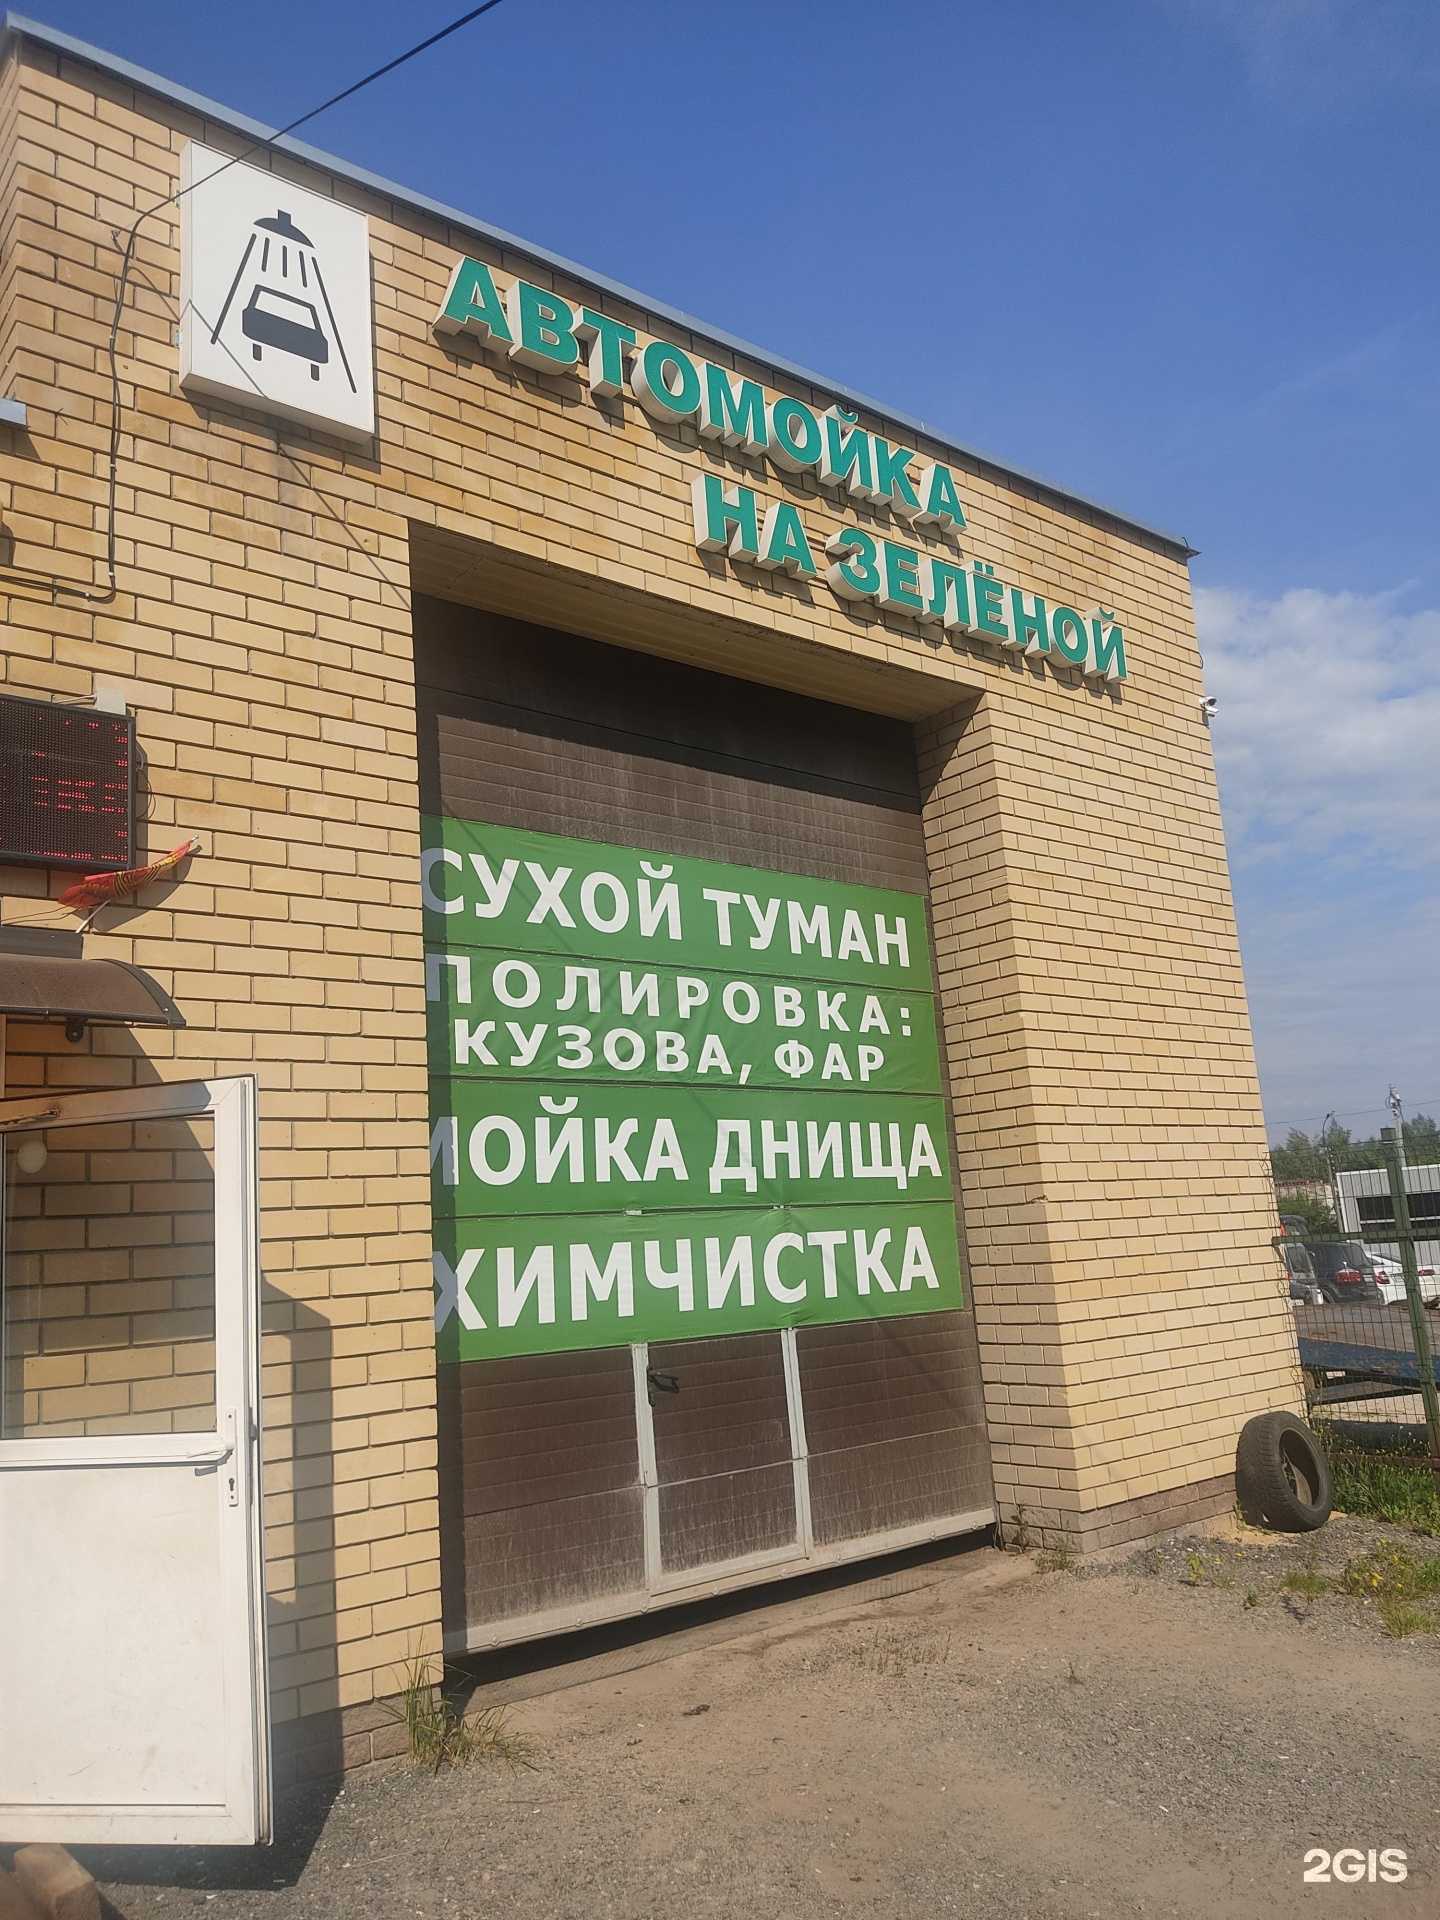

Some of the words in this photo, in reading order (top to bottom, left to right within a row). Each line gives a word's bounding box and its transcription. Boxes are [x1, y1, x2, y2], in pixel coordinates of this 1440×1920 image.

[432, 255, 968, 536] АВТОМОЙКА
[692, 473, 818, 583] НА
[825, 526, 1129, 684] ЗЕЛЁНОЙ
[421, 847, 683, 941] СУХОЙ
[702, 888, 911, 968] ТУМАН
[426, 952, 913, 1037] ПОЛИРОВКА:
[453, 1018, 753, 1085] КУЗОВА,
[773, 1039, 886, 1082] ФАР
[708, 1118, 943, 1194] ДНИЩА
[432, 1226, 940, 1332] ХИМЧИСТКА
